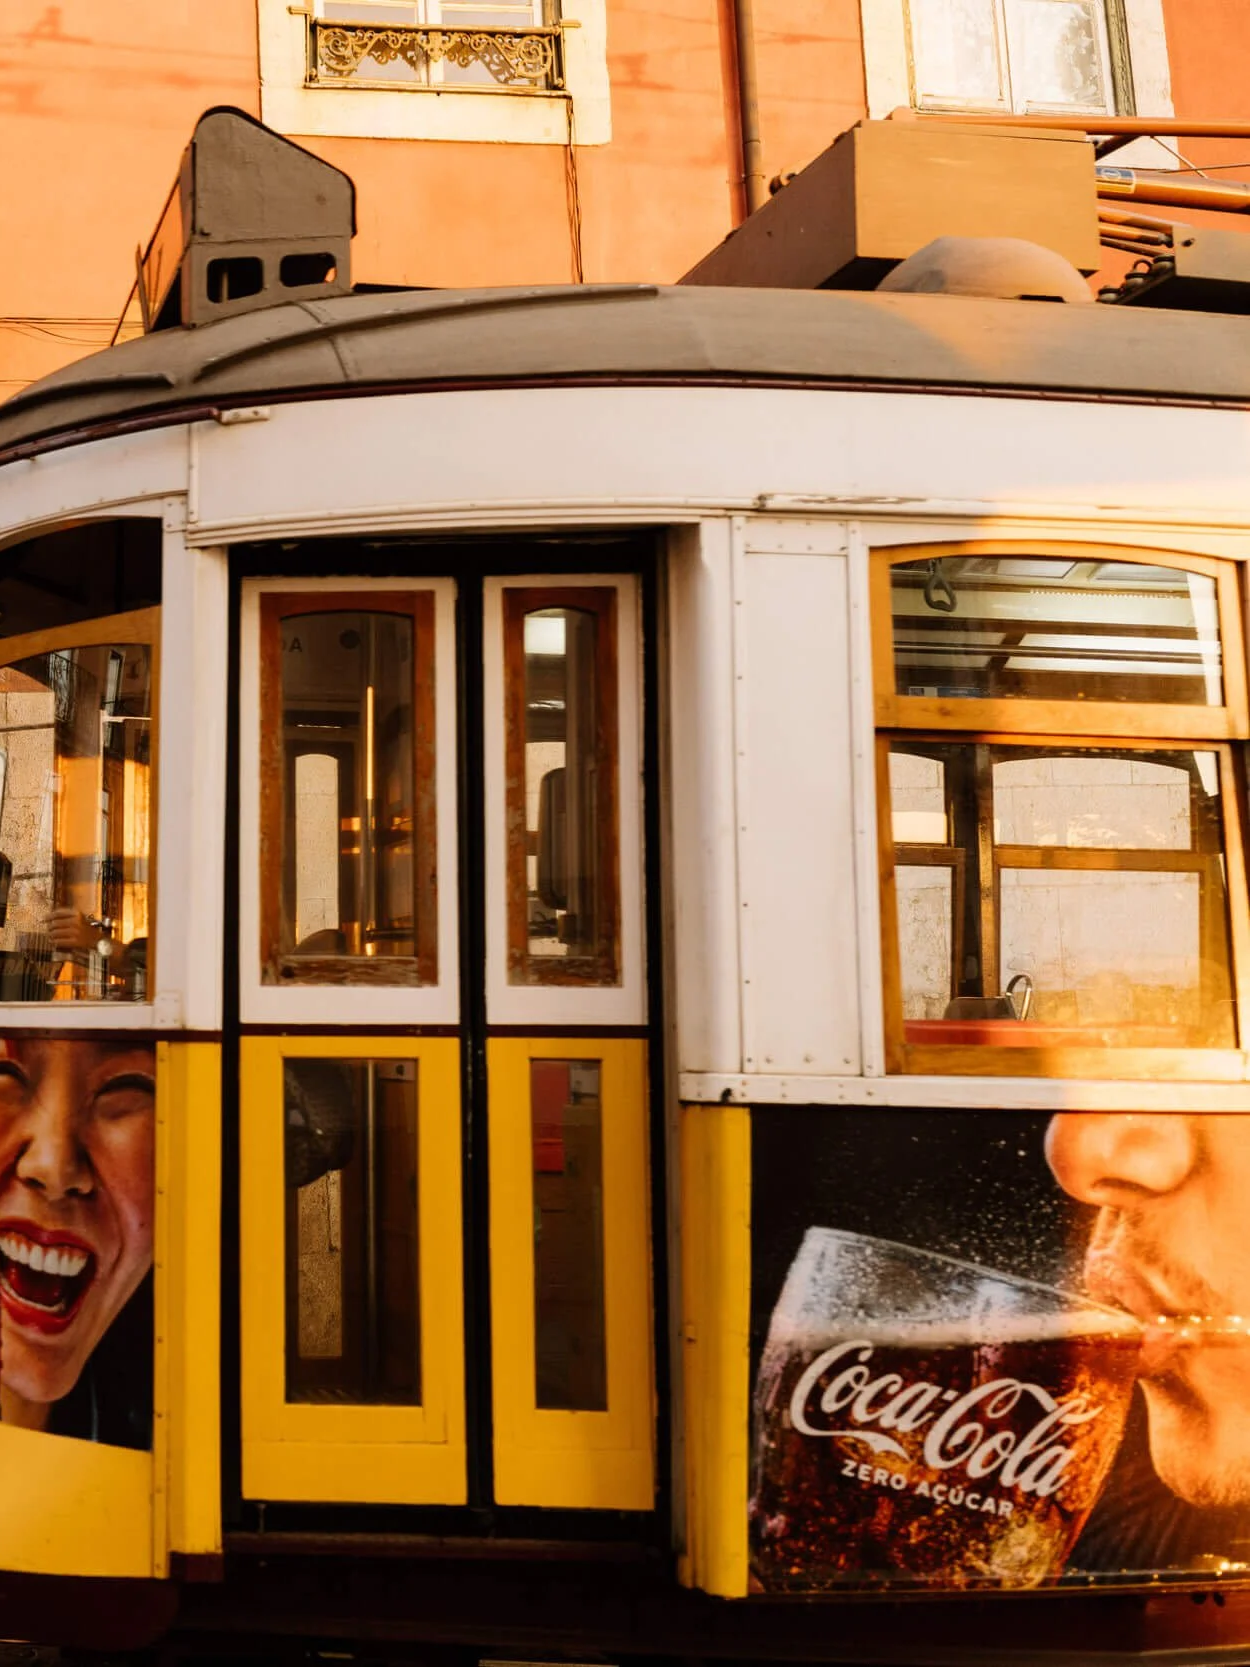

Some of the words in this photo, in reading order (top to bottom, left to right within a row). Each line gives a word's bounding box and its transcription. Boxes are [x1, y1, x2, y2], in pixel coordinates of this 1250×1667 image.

[790, 1340, 1103, 1497] Coca-Cola
[841, 1459, 908, 1491] ZERO
[915, 1481, 1014, 1518] AÇÚCAR
